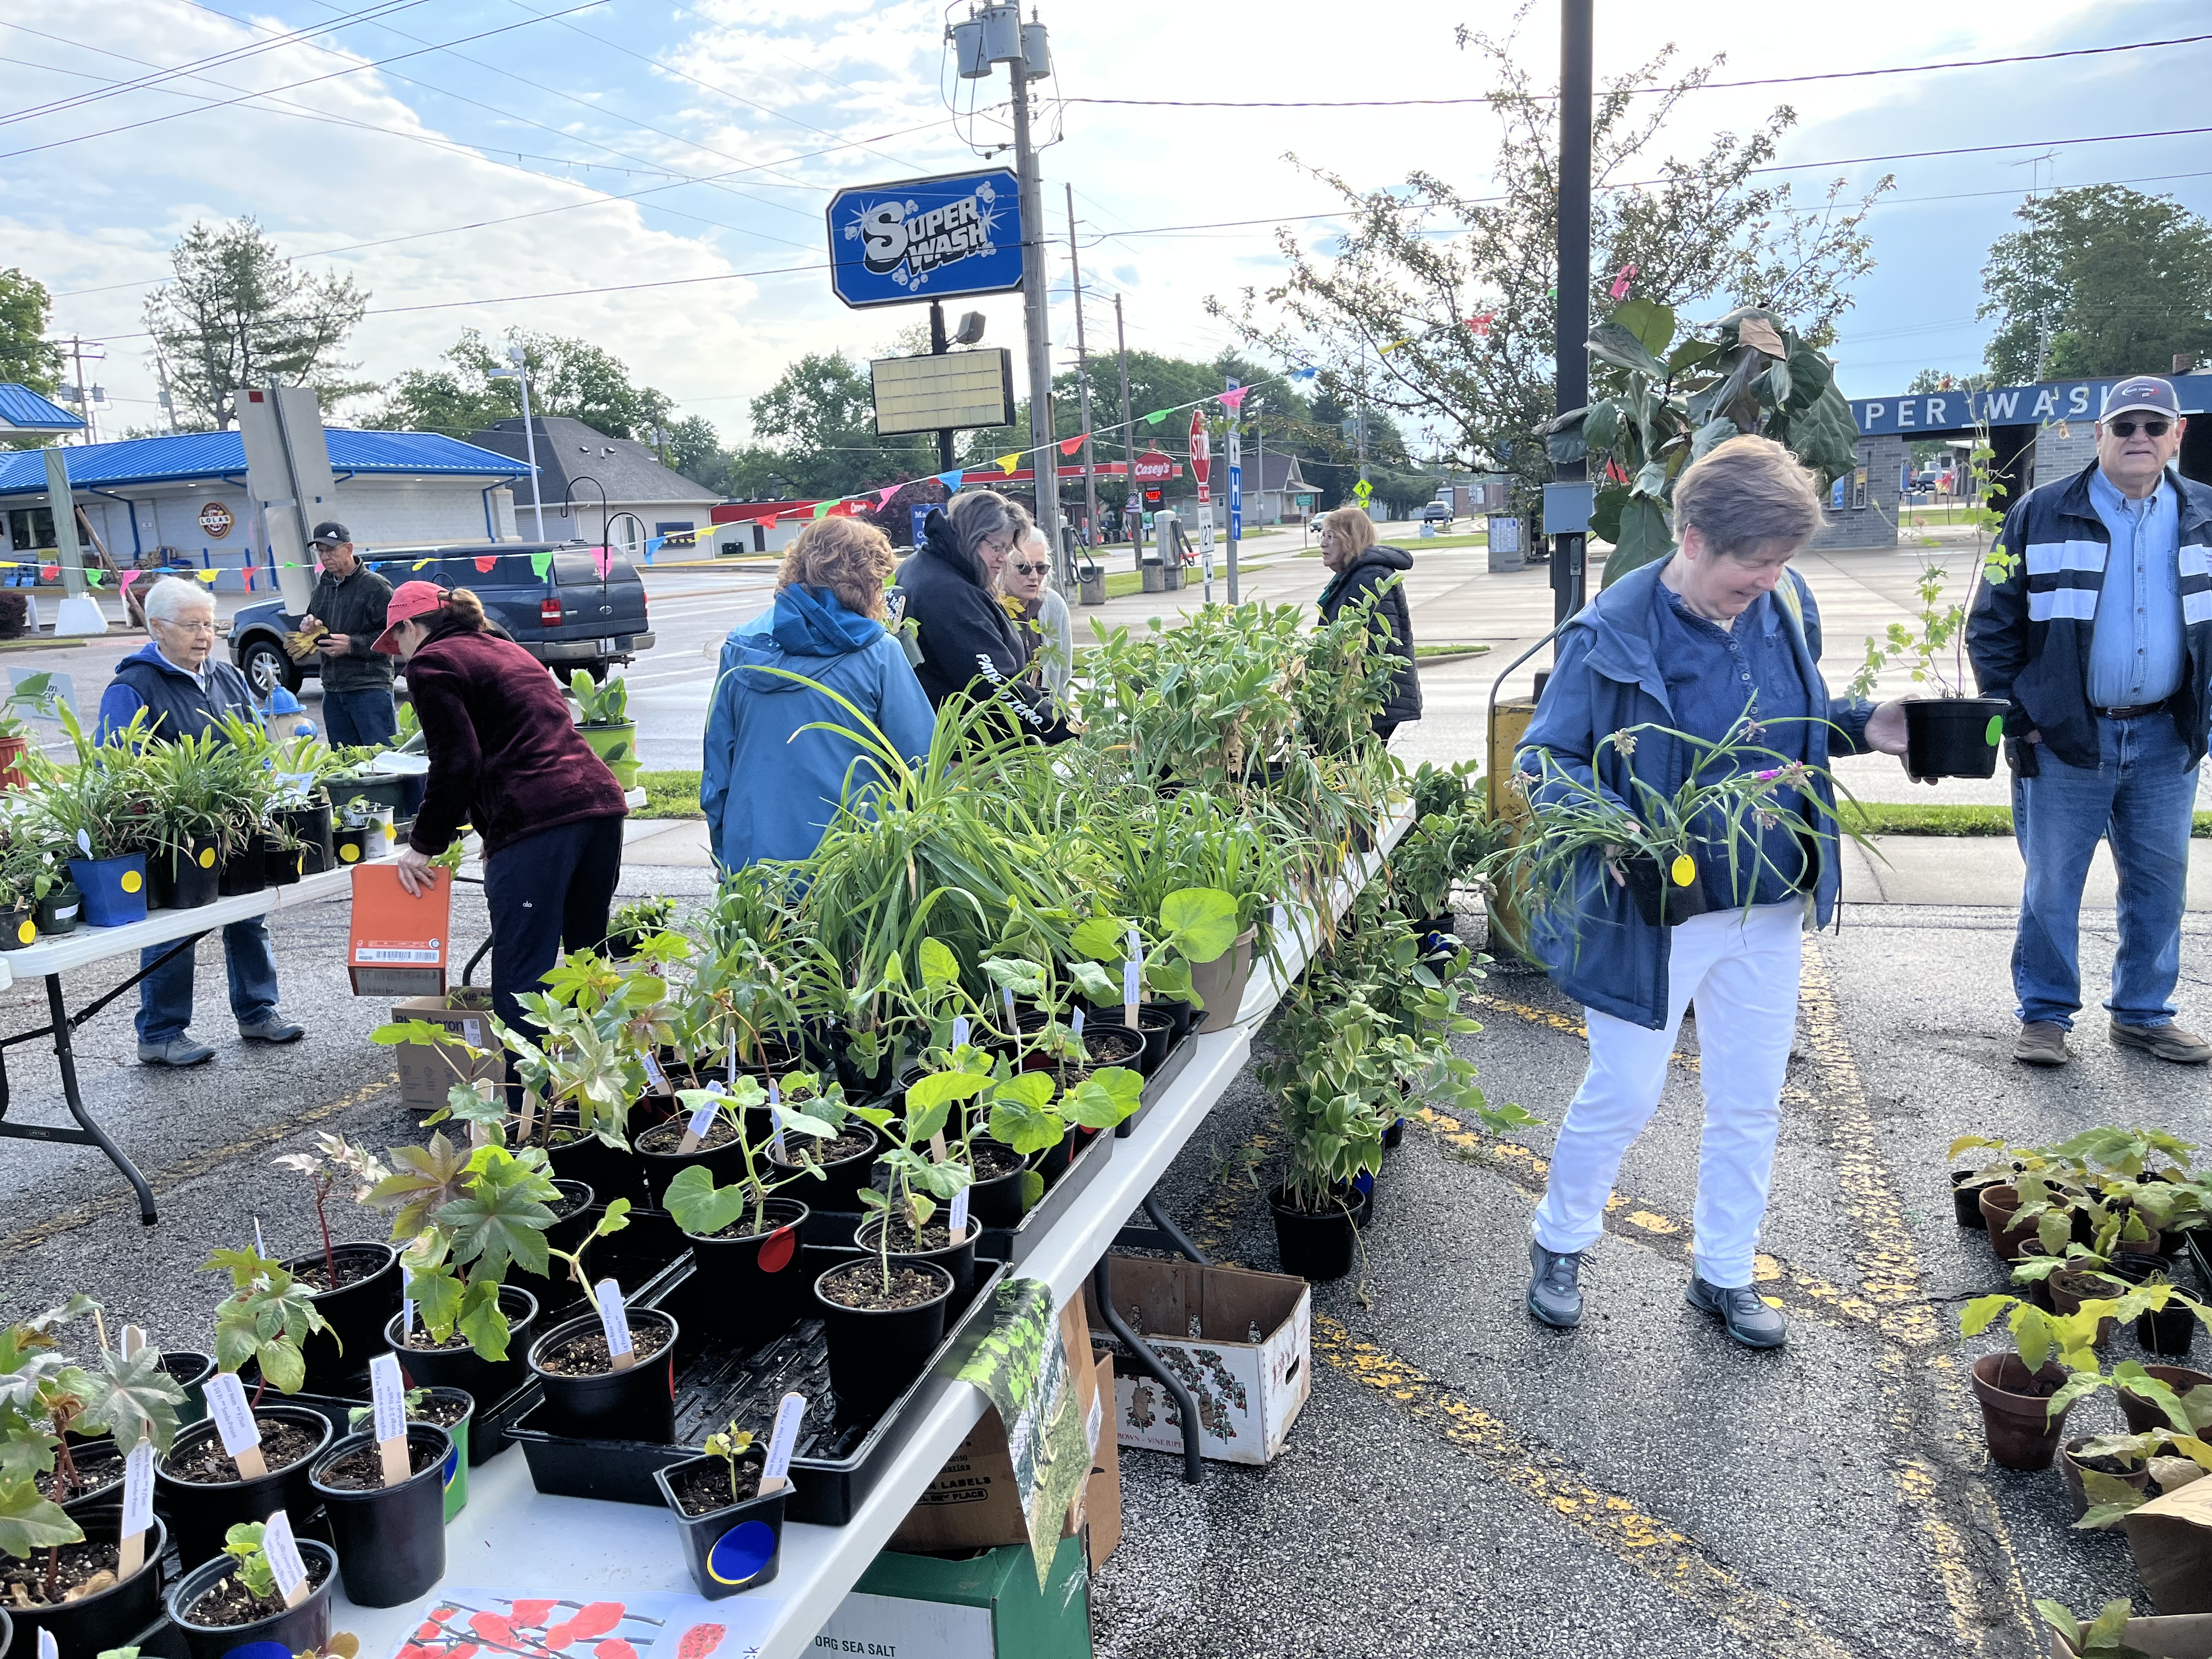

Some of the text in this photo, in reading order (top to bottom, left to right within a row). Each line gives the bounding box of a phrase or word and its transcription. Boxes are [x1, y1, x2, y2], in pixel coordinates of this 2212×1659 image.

[863, 196, 980, 263] SUPER
[909, 223, 987, 268] WASH
[1850, 397, 1946, 429] PER
[1192, 434, 1209, 461] STOP
[1135, 462, 1170, 477] Casey's
[1231, 472, 1239, 507] H
[1201, 524, 1211, 546] 127
[976, 653, 1001, 683] PATH
[1006, 699, 1043, 724] ZERO
[618, 1321, 627, 1345] Fruit/Vine
[223, 1376, 232, 1393] Castor
[236, 1412, 245, 1428] F/Sun
[376, 1387, 386, 1441] Pumpkin-on-a-stick
[221, 1406, 236, 1439] Seeds-Poison
[770, 1440, 781, 1461] Hyacinth
[782, 1402, 791, 1419] F/Sun
[1117, 1432, 1139, 1441] ROWN
[775, 1464, 783, 1476] Vine
[941, 1477, 991, 1489] LABELS
[952, 1490, 985, 1500] PLACE
[815, 1635, 896, 1657] ORG SEA SALT
